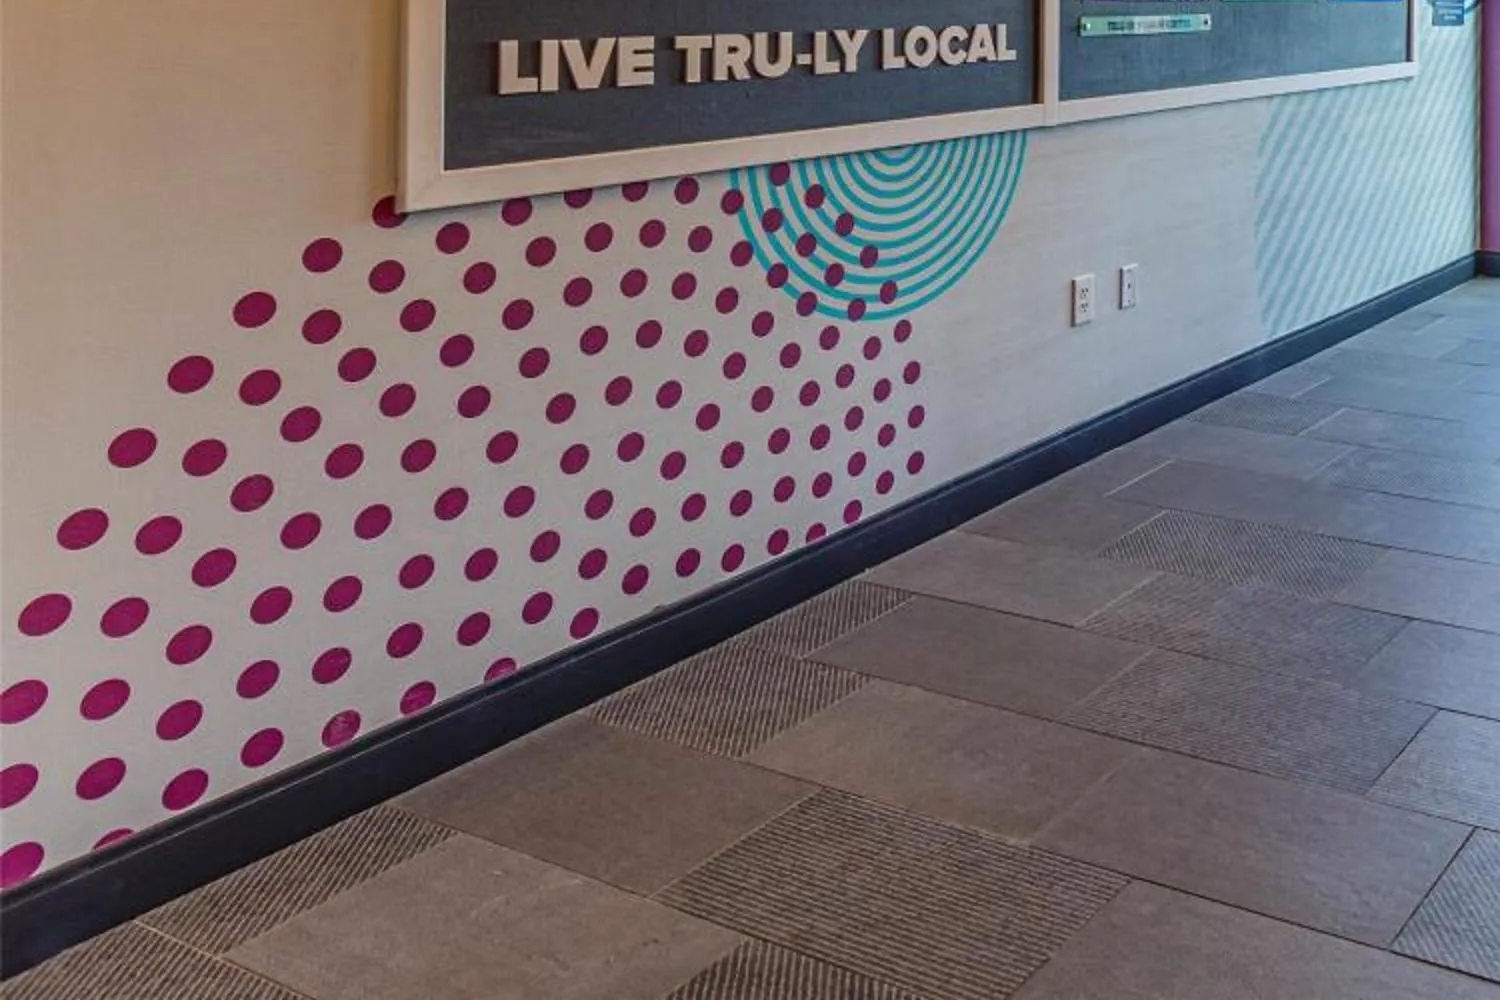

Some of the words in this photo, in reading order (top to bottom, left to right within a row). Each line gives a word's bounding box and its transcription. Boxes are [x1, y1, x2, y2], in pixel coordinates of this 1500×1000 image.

[498, 35, 655, 95] LIVE
[674, 29, 869, 84] TRU-LY
[881, 23, 1017, 71] LOCAL
